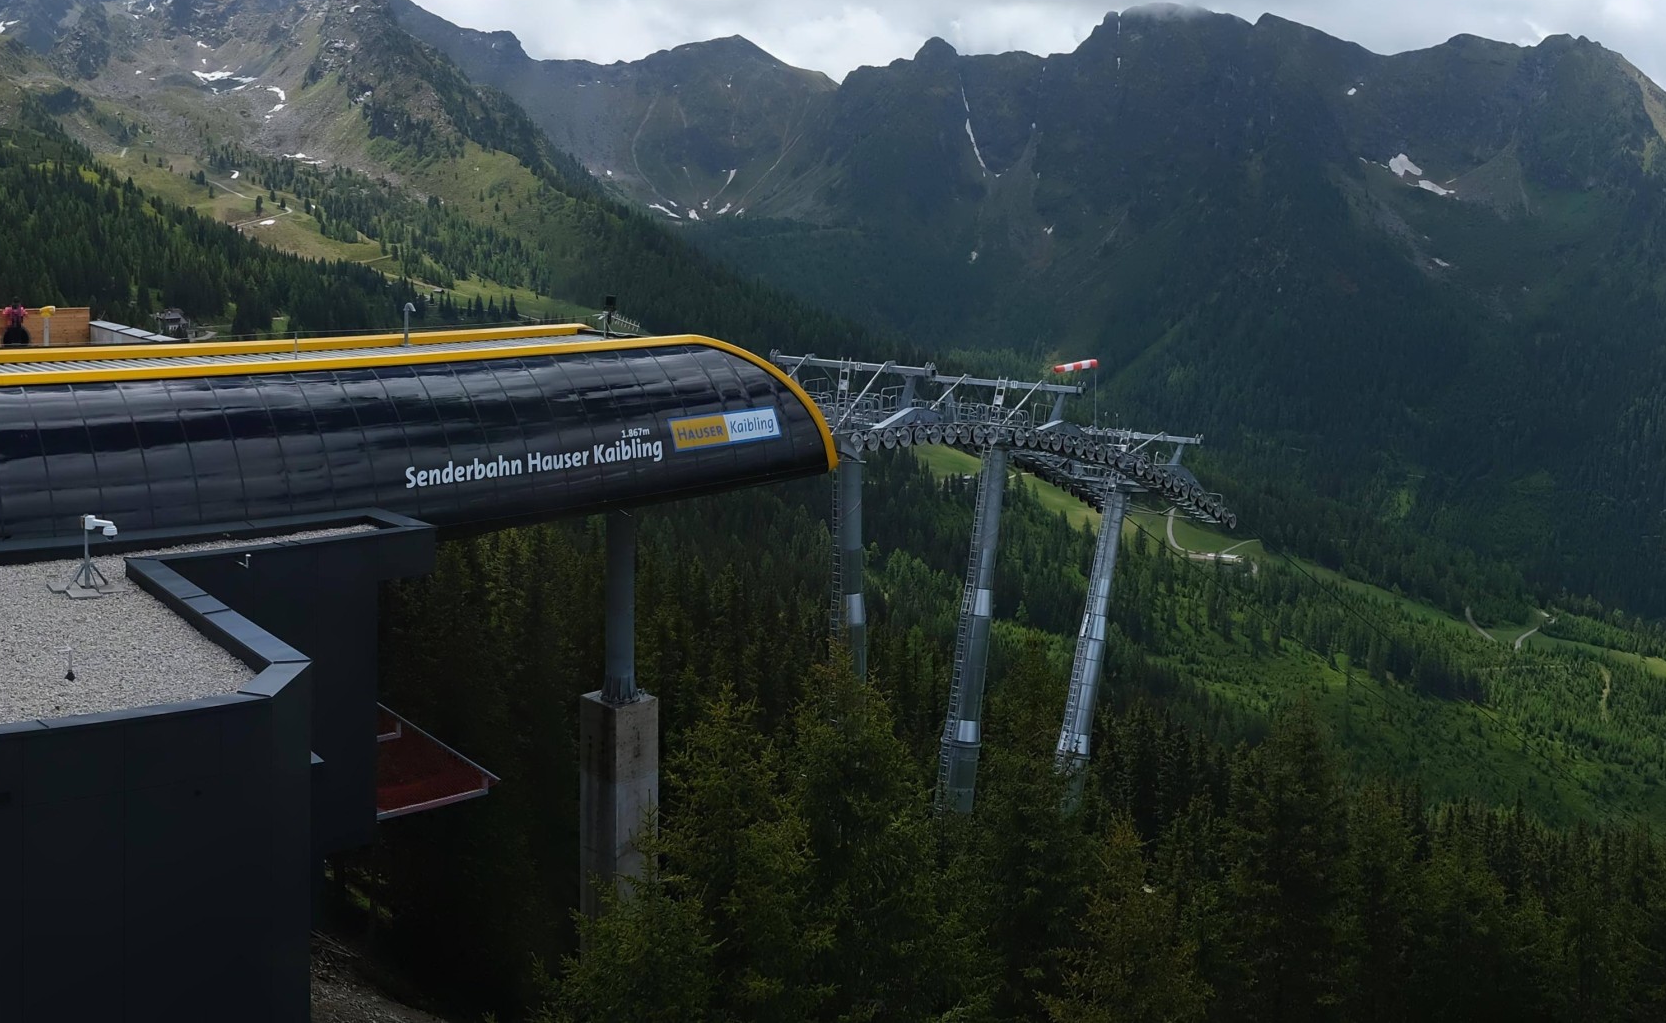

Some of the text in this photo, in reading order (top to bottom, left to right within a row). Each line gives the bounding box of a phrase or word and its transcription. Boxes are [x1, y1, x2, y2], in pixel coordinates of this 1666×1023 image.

[621, 428, 650, 438] 1.867m
[677, 418, 774, 441] HAUSER Kaibling
[405, 440, 663, 488] Senderbahn Hauser Kaibling
